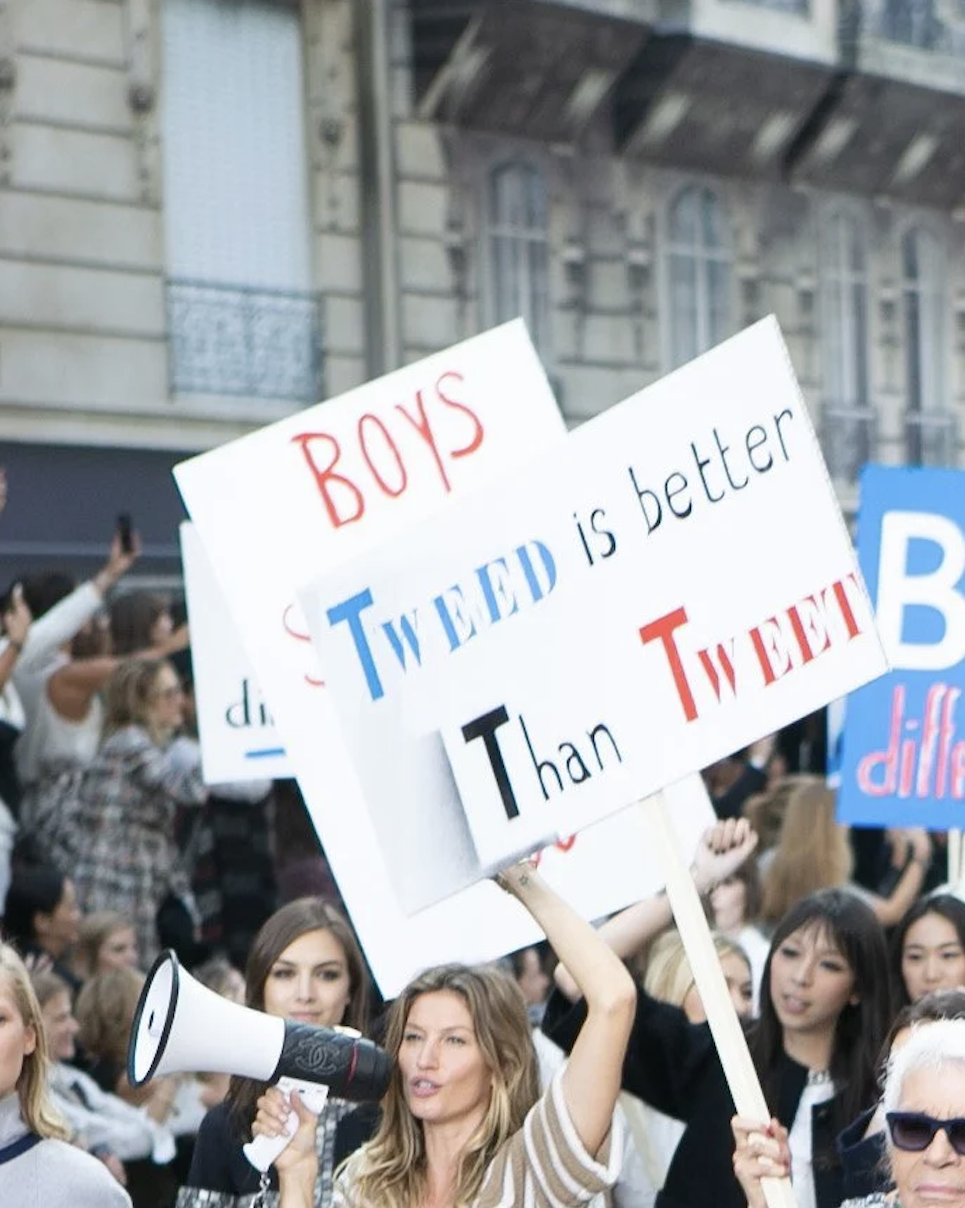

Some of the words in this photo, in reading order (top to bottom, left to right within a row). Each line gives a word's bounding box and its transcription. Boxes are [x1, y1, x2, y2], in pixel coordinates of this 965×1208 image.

[291, 371, 485, 528] BOYS
[573, 506, 618, 567] is
[628, 408, 795, 535] better
[461, 704, 622, 820] Than
